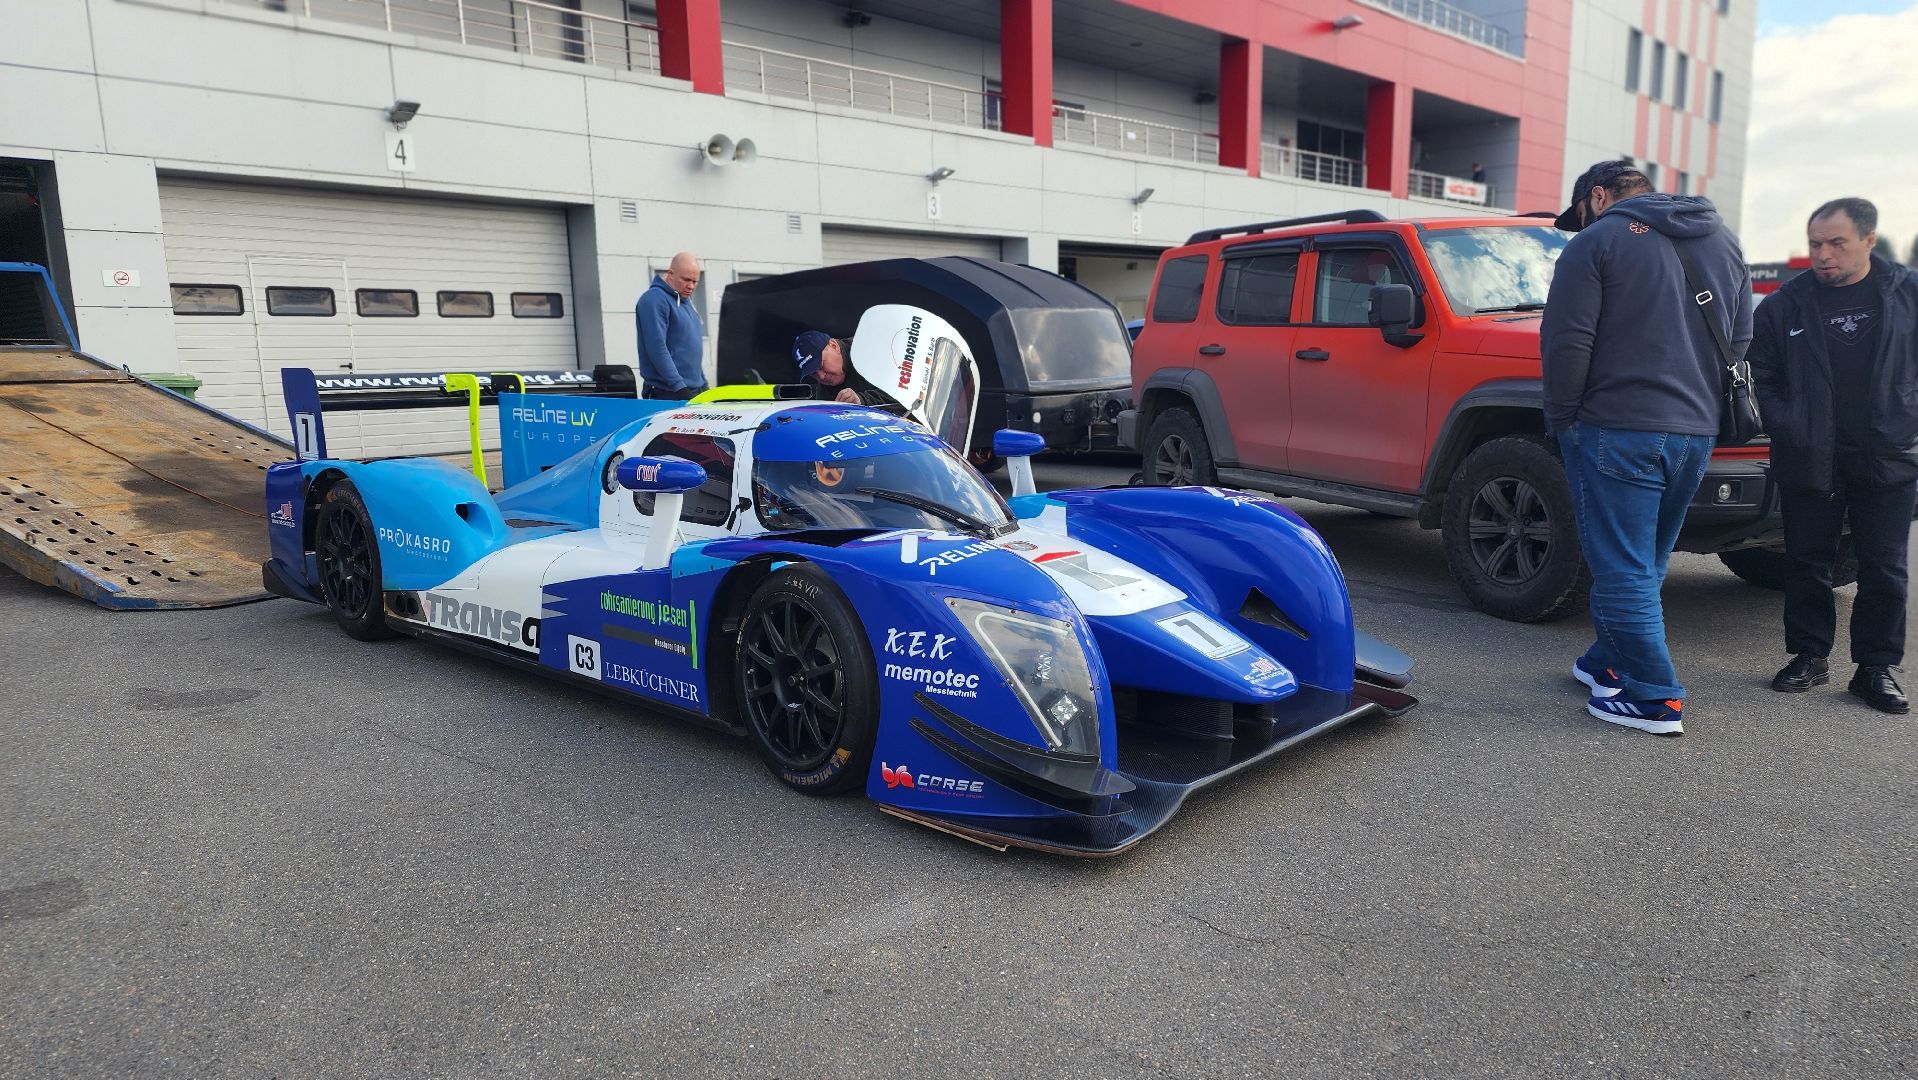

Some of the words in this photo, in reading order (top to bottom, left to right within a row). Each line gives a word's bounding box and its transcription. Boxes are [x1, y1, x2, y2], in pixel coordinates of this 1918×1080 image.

[394, 139, 406, 165] 4
[930, 196, 937, 215] 3
[898, 315, 923, 390] resinnovation
[379, 527, 451, 554] PROKASRO
[600, 589, 656, 624] rohrsanierung
[575, 643, 595, 671] C3
[605, 661, 700, 703] LEBKÜCHNER
[884, 663, 980, 689] memotec
[925, 684, 978, 699] Messtechnik
[917, 773, 985, 793] CORSE
